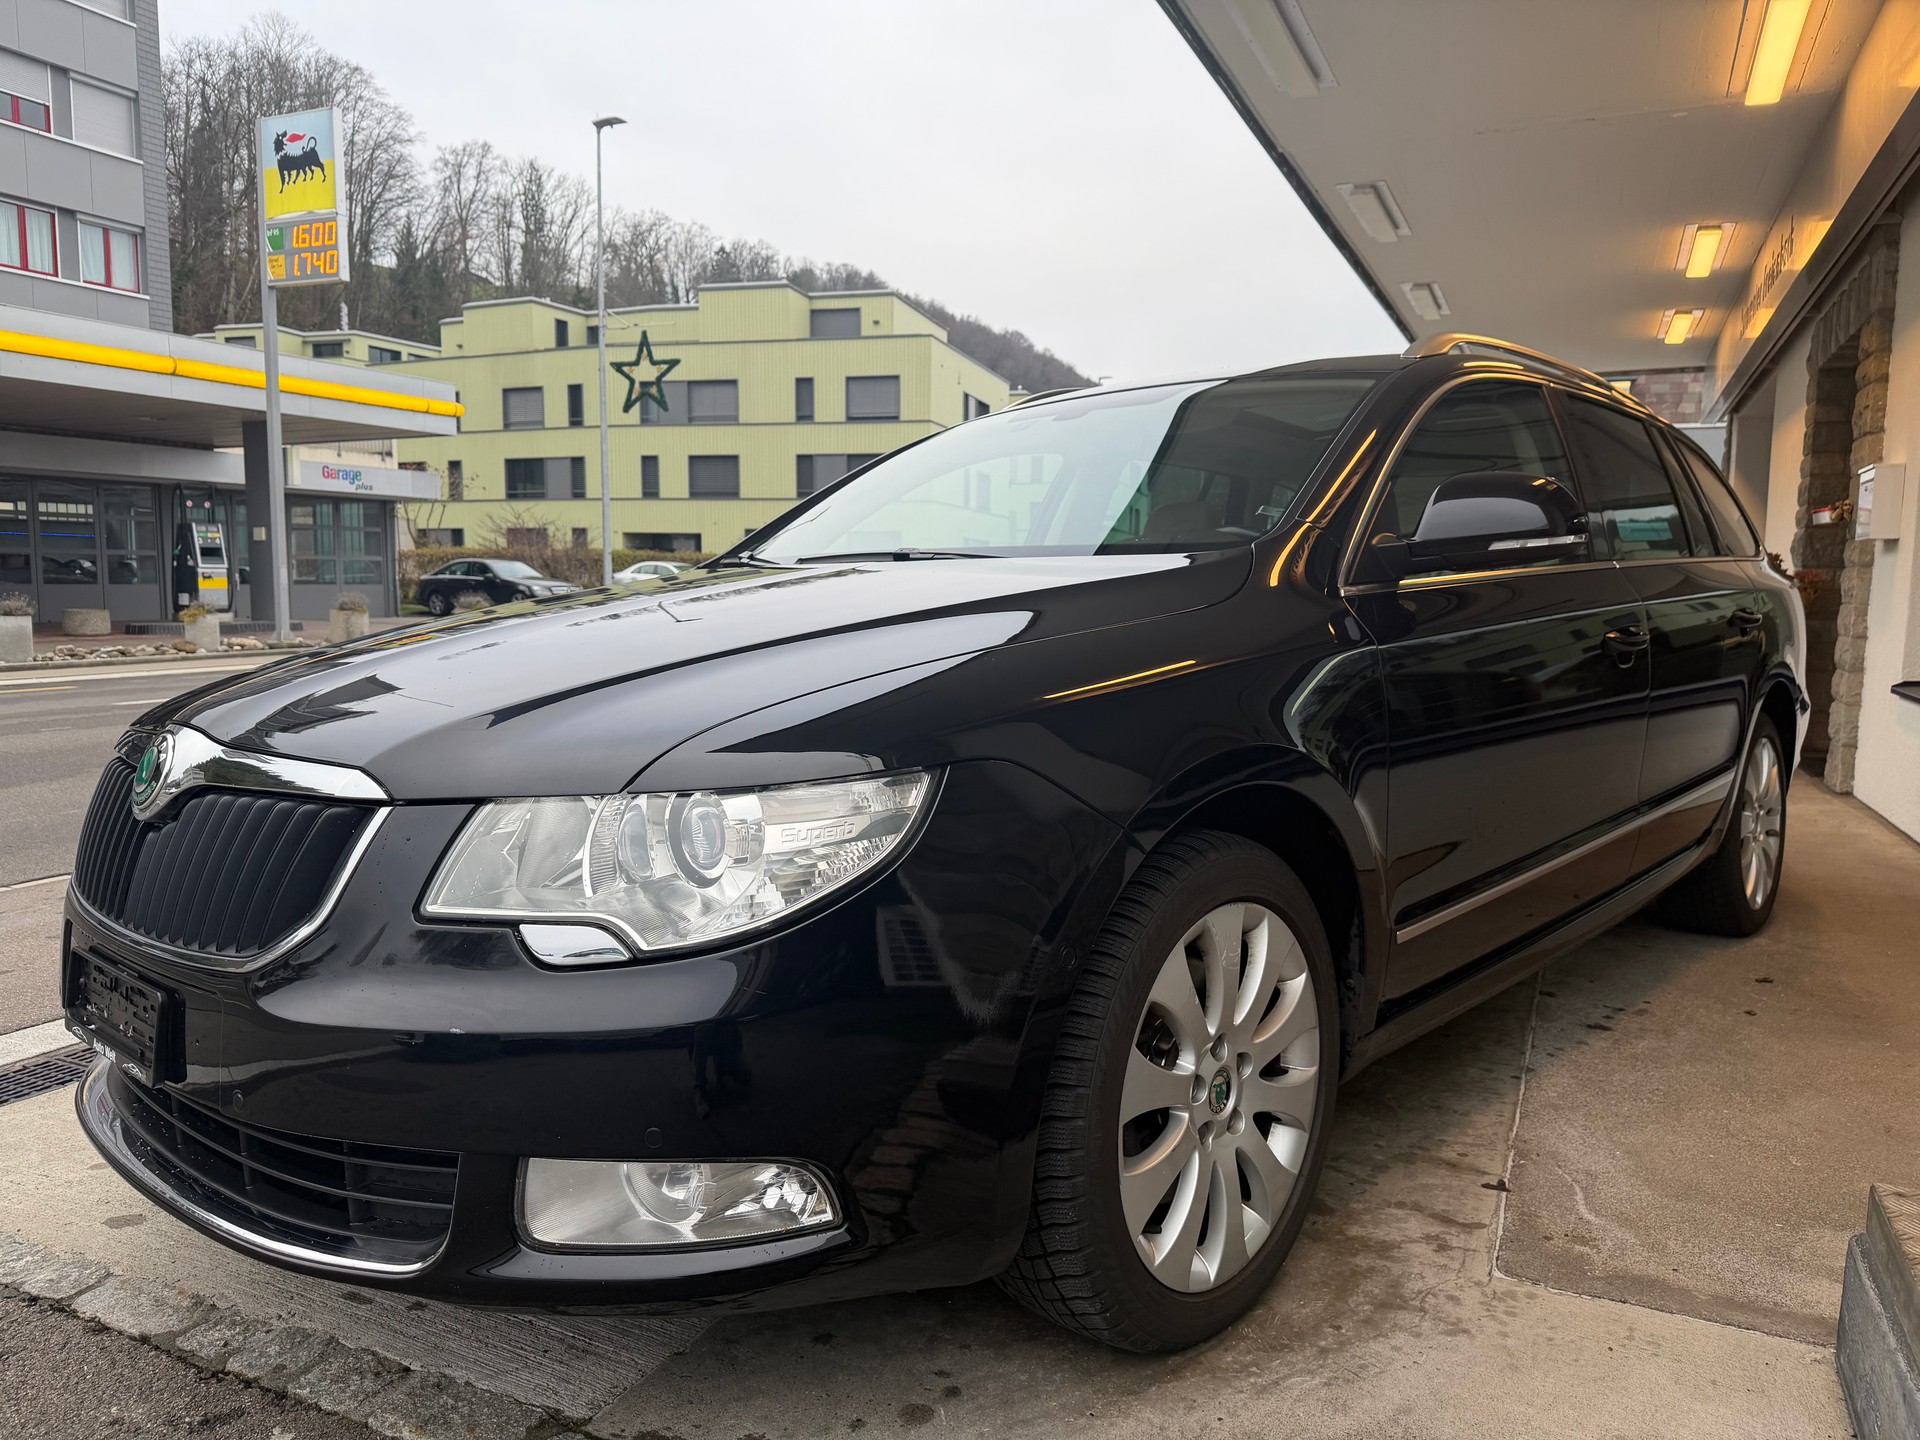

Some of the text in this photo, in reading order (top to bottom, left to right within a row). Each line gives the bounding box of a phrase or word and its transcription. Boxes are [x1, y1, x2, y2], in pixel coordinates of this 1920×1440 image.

[322, 464, 362, 485] Garage
[355, 482, 373, 491] plus
[781, 821, 857, 845] Superb
[93, 1038, 105, 1055] Auto
